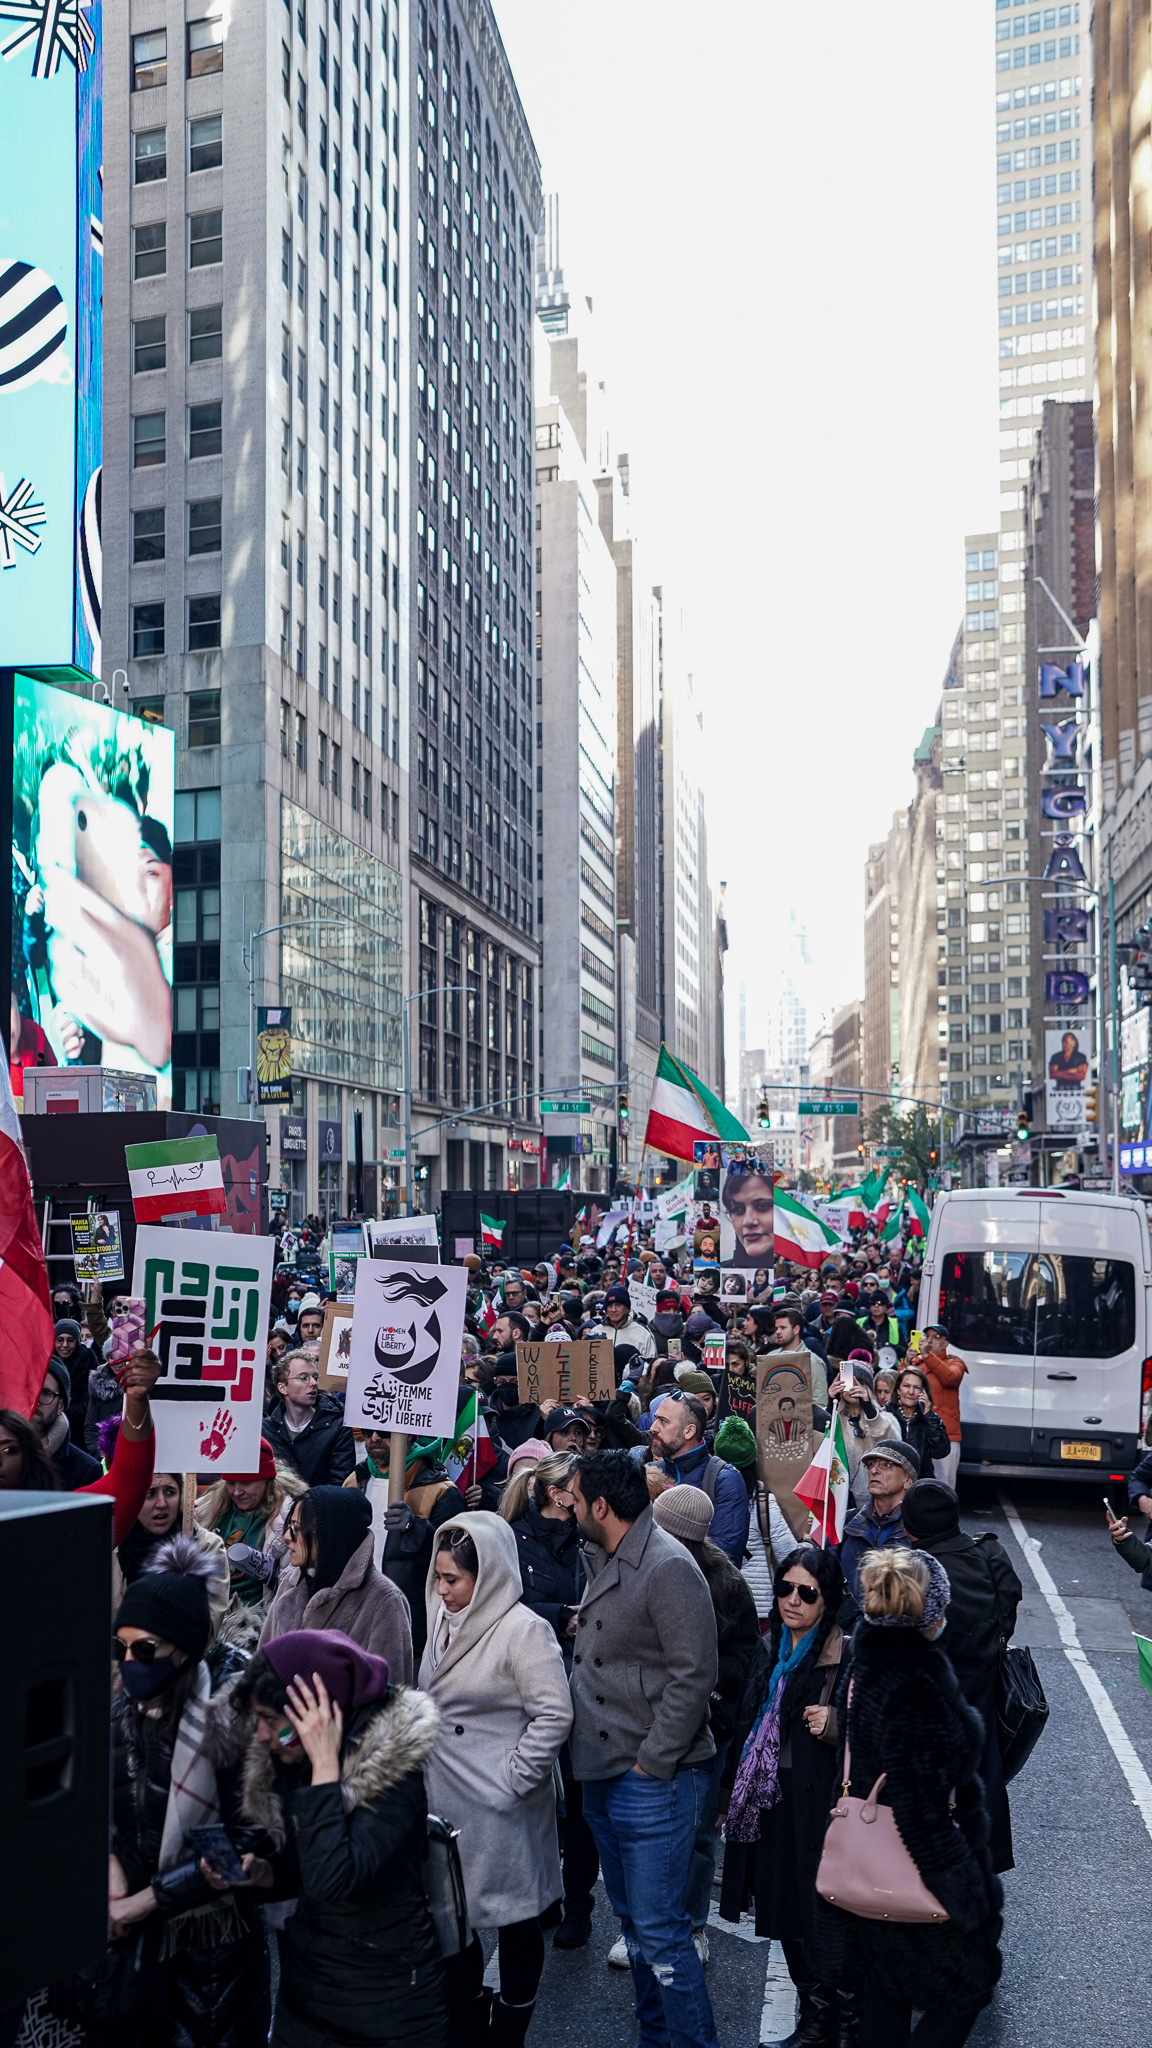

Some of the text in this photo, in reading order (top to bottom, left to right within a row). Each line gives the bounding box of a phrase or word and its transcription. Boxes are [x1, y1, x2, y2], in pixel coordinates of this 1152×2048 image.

[270, 1085, 283, 1093] SHOW
[812, 1104, 844, 1112] W 41 St
[288, 1125, 302, 1137] PARIS
[283, 1138, 307, 1151] BAGUETTE
[666, 1194, 678, 1205] OUR
[666, 1197, 685, 1212] BLOOD
[97, 1245, 111, 1253] STOOD
[382, 1333, 395, 1342] LIFE
[381, 1341, 407, 1350] LIBERTY
[523, 1346, 540, 1403] WOMEN
[555, 1343, 570, 1402] LIFE
[587, 1341, 611, 1401] FREEDOM
[398, 1384, 433, 1401] FEMME
[397, 1397, 413, 1412] VIE
[395, 1412, 433, 1428] LIBERTÉ
